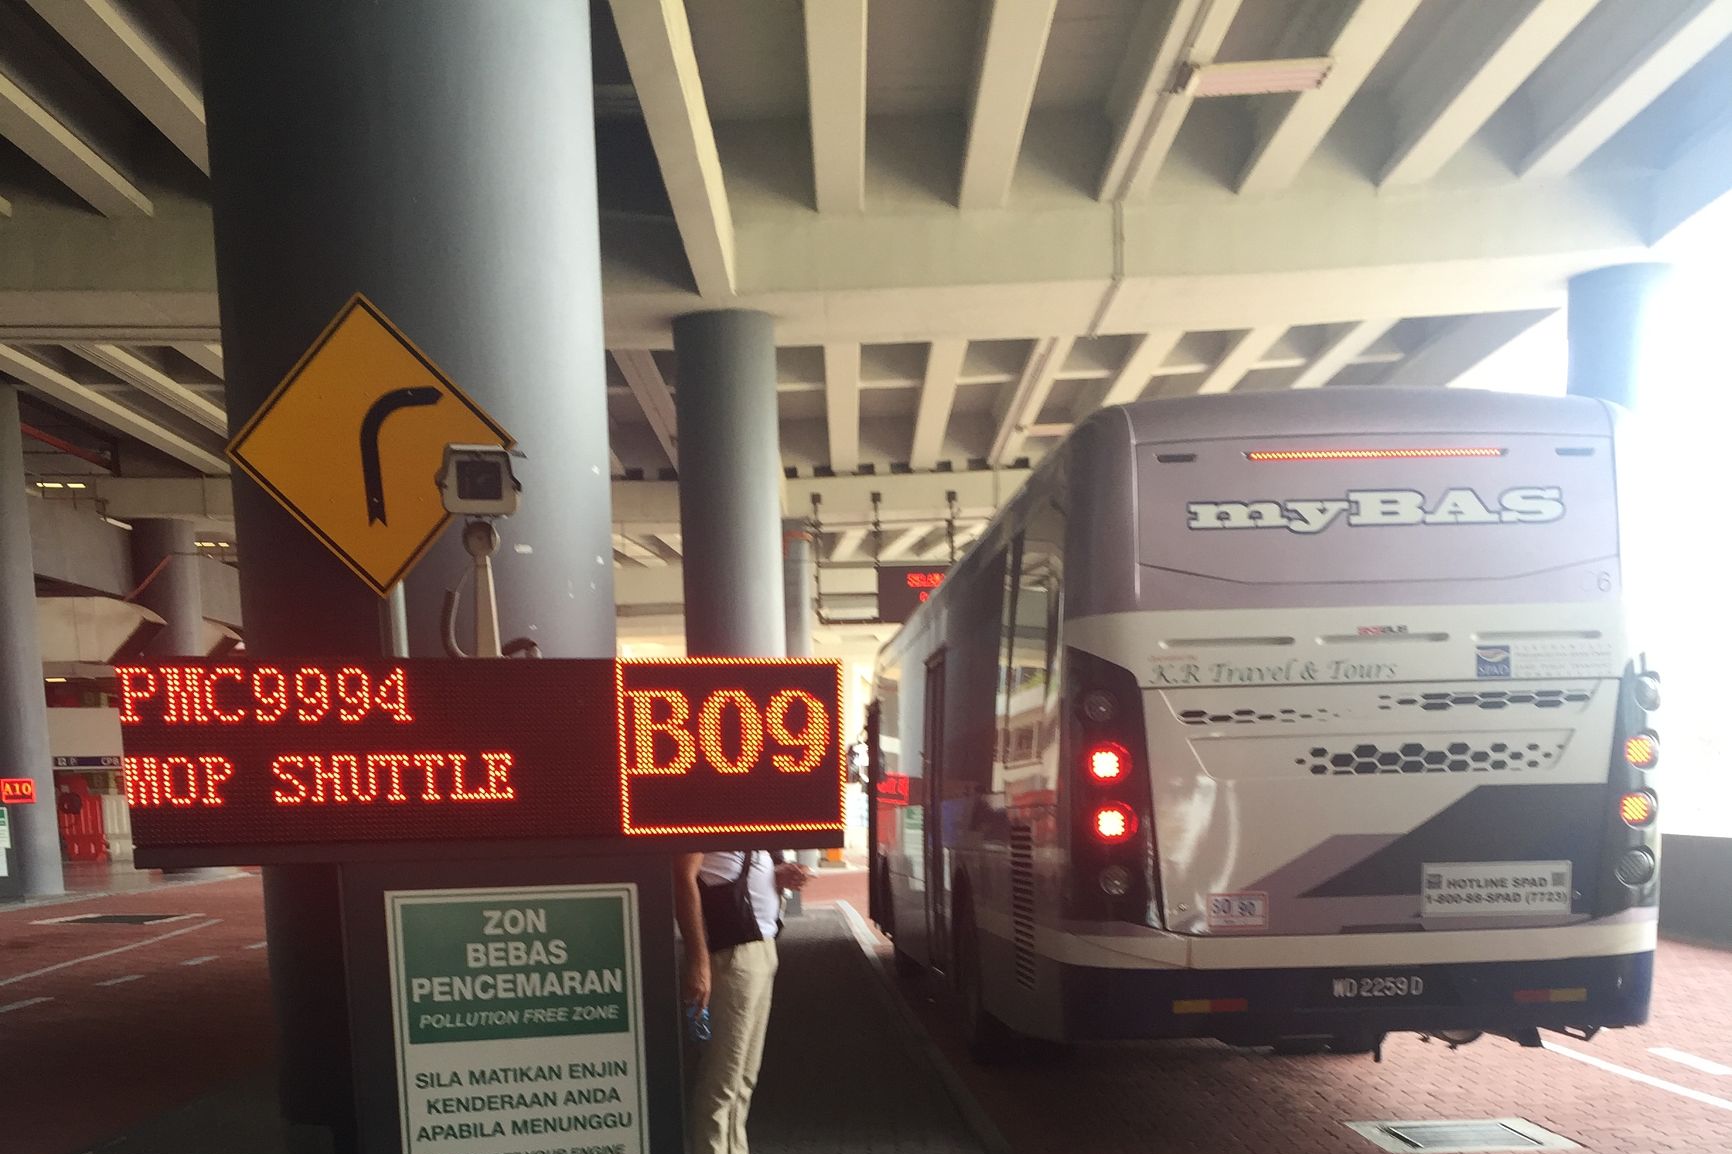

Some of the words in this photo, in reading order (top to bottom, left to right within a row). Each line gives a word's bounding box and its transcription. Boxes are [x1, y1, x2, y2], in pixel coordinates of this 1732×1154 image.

[1187, 487, 1567, 535] myBAS
[1211, 658, 1298, 682] Travel
[1301, 661, 1316, 682] &
[1329, 658, 1397, 681] Tours
[114, 666, 413, 722] PMC9994
[623, 690, 830, 774] B09
[124, 756, 235, 806] MOP
[272, 753, 515, 804] SHUTTLE
[1447, 877, 1509, 890] HOTLINE
[1511, 876, 1548, 889] SPAD
[1525, 891, 1568, 905] (7723)
[483, 908, 547, 935] ZON
[466, 939, 568, 968] BEBAS
[411, 968, 623, 1003] PENCEMARAN
[419, 1010, 519, 1029] POLLUTION
[523, 1006, 569, 1024] FREE
[571, 1004, 620, 1022] ZONE
[415, 1070, 463, 1090] SILA
[468, 1064, 562, 1087] MATIKAN
[569, 1060, 628, 1080] ENJIN
[426, 1091, 558, 1115] KENDERAAN
[563, 1087, 622, 1106] ANDA
[416, 1120, 506, 1142] APABILA
[511, 1112, 632, 1136] MENUNGGU
